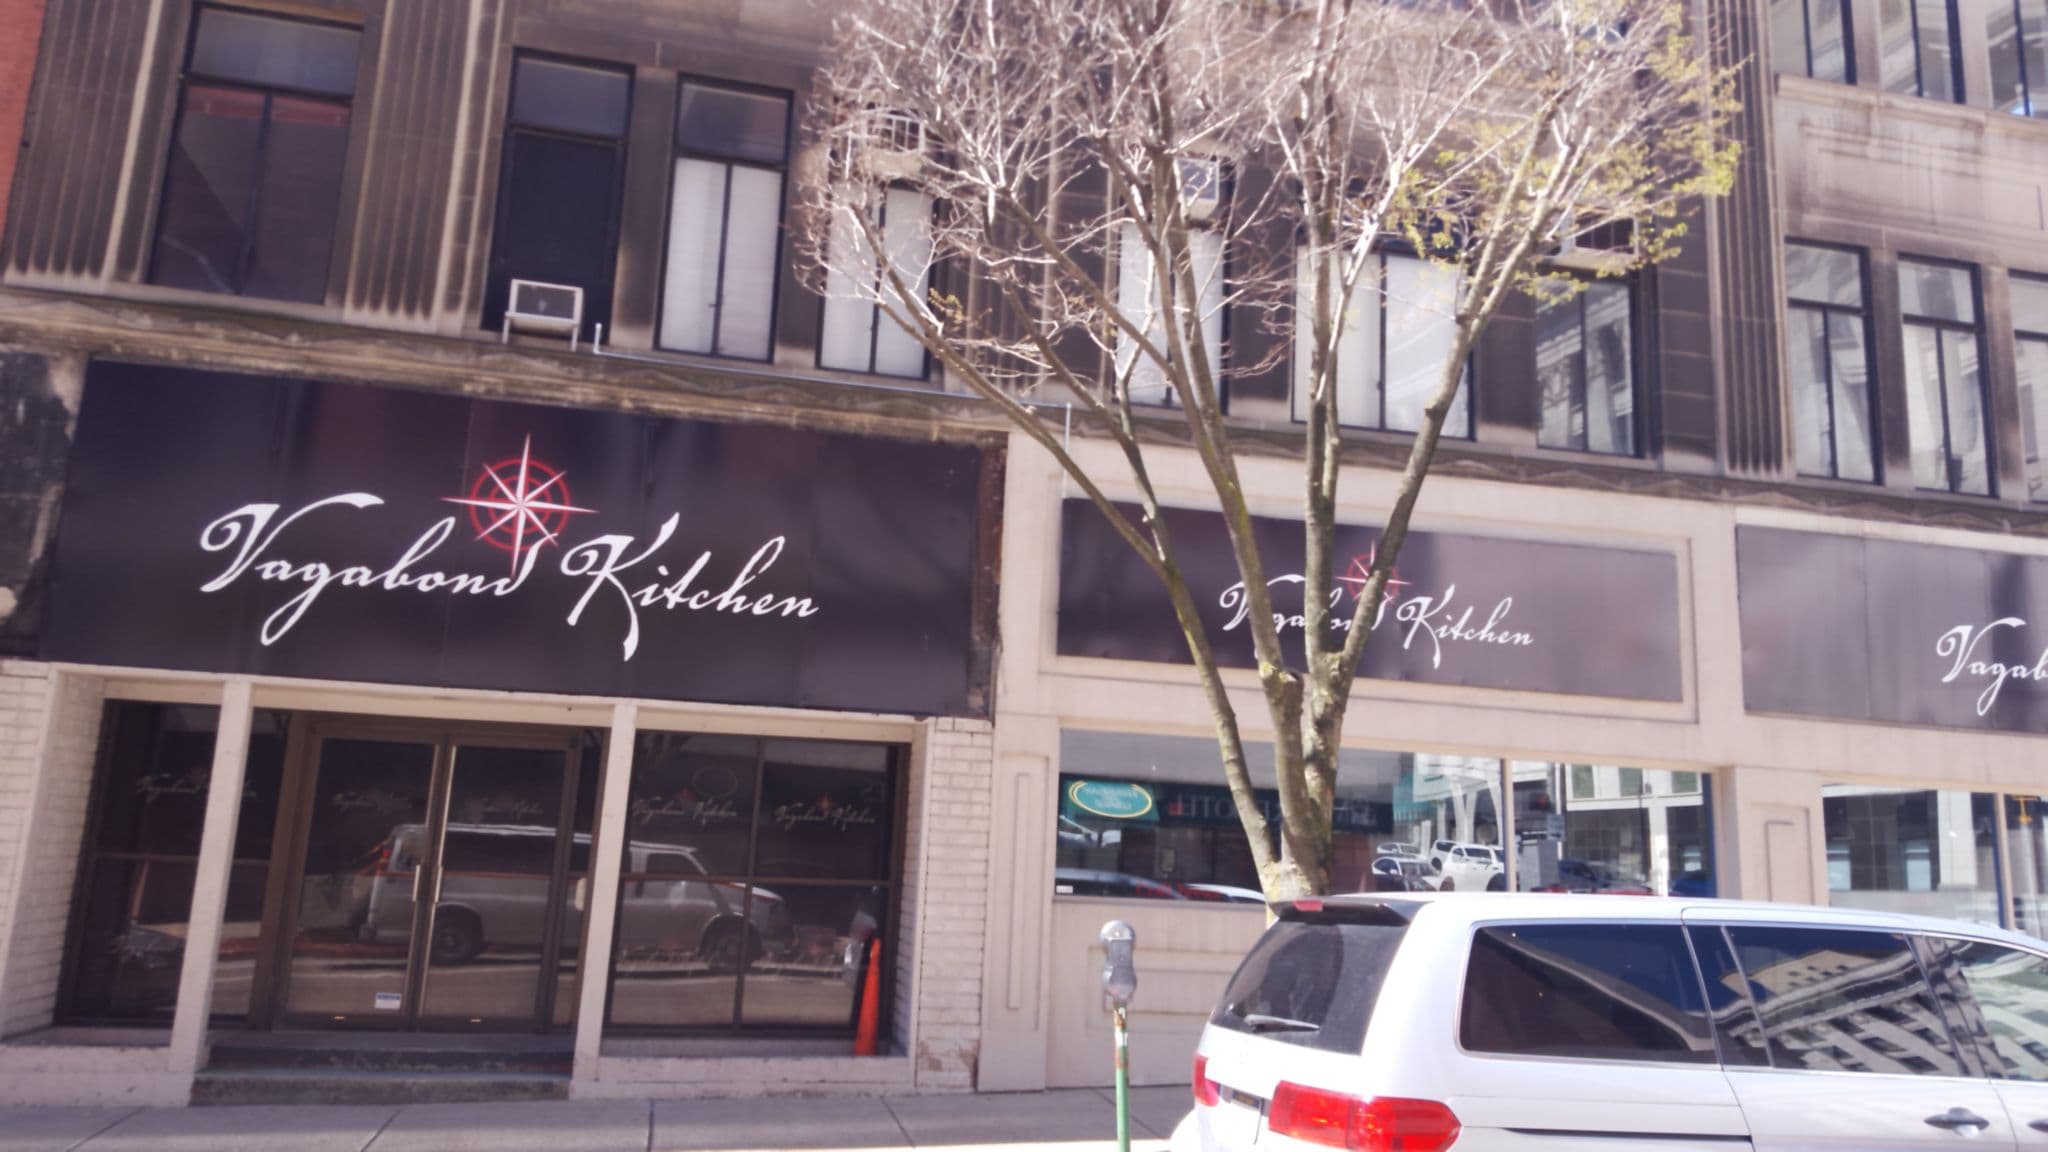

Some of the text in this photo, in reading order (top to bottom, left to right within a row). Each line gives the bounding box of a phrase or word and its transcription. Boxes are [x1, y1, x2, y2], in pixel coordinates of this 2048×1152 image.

[200, 492, 819, 661] Vagabond Kitchen
[1219, 573, 1534, 670] Vaond Kitchen
